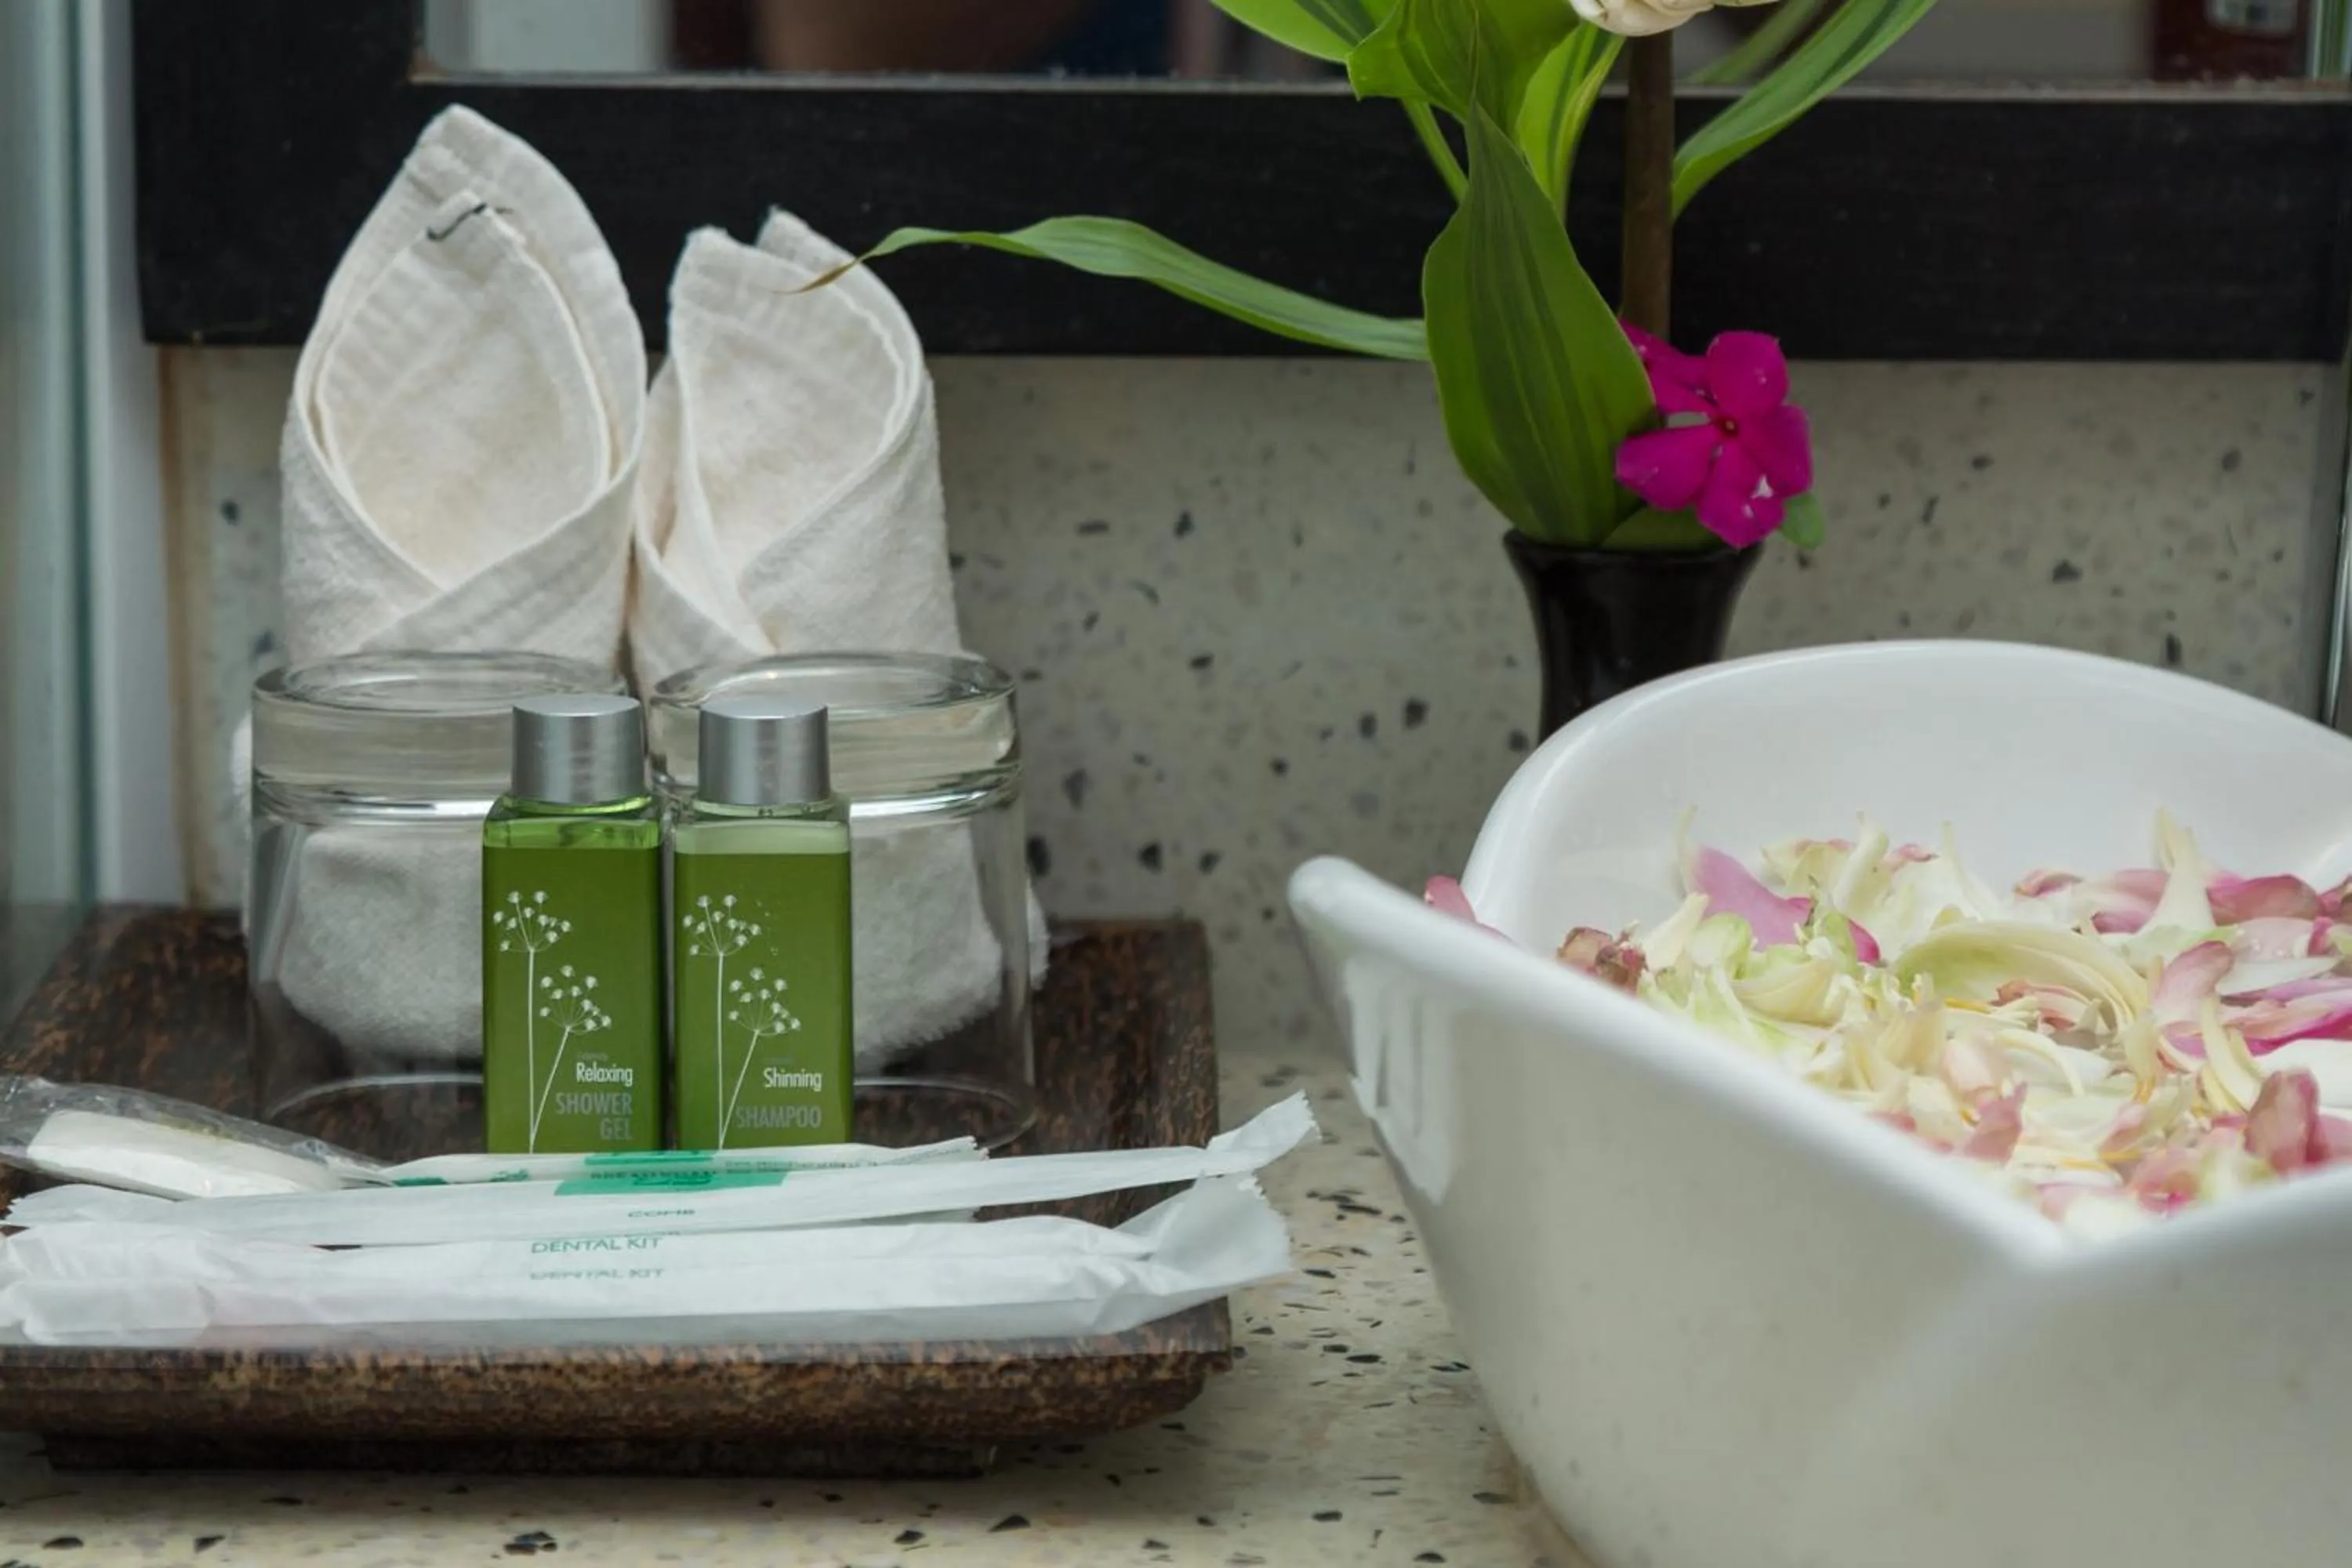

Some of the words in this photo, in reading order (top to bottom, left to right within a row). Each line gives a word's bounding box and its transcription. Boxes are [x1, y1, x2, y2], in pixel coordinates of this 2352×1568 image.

[576, 1061, 633, 1087] Relaxing
[763, 1066, 822, 1092] Shinning
[555, 1091, 633, 1115] SHOWER
[736, 1105, 822, 1128] SHAMPOO
[601, 1117, 633, 1140] GEL
[531, 1239, 622, 1254] DENTAL
[627, 1236, 663, 1250] KIT
[629, 1267, 664, 1279] KIT
